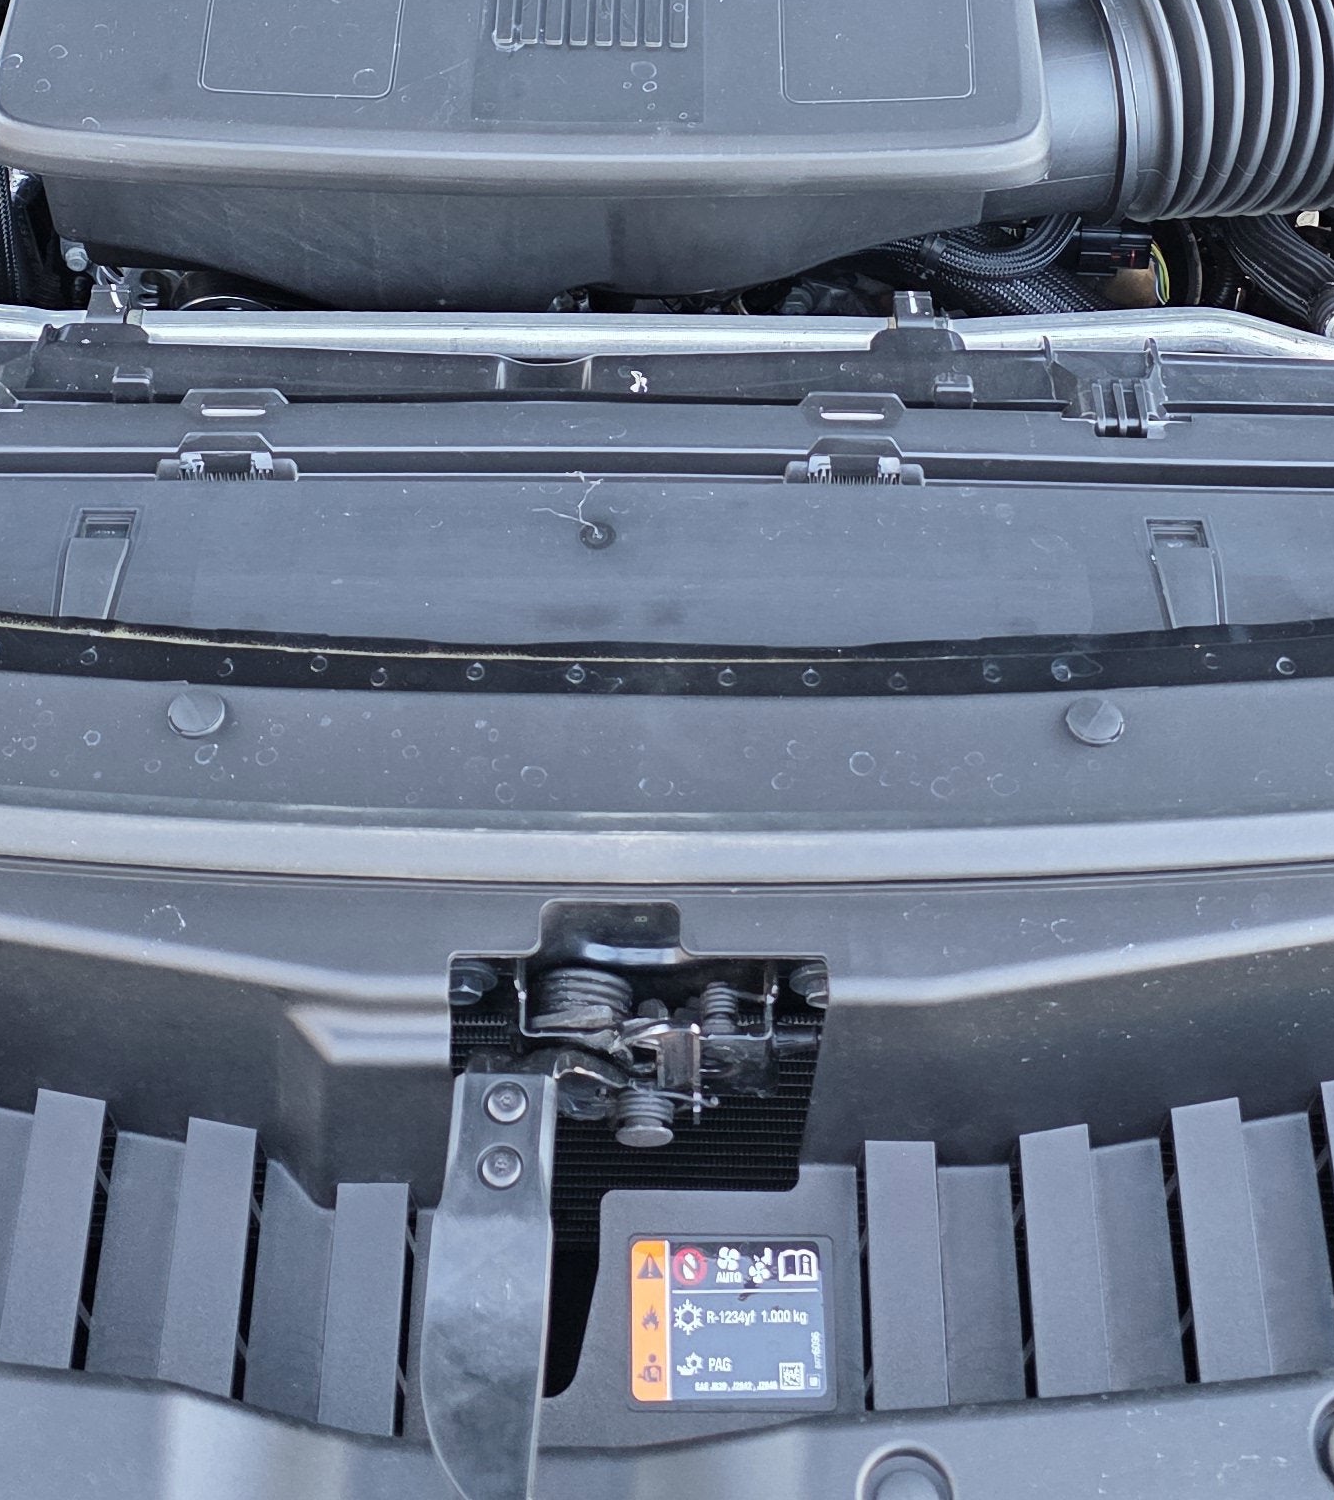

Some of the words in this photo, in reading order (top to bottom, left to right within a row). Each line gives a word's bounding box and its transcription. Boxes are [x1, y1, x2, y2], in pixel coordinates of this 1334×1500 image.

[716, 1272, 742, 1283] AUTO
[706, 1310, 755, 1326] R-1234yf
[761, 1310, 791, 1323] 1.000
[793, 1309, 808, 1325] kg
[708, 1357, 733, 1372] PAG
